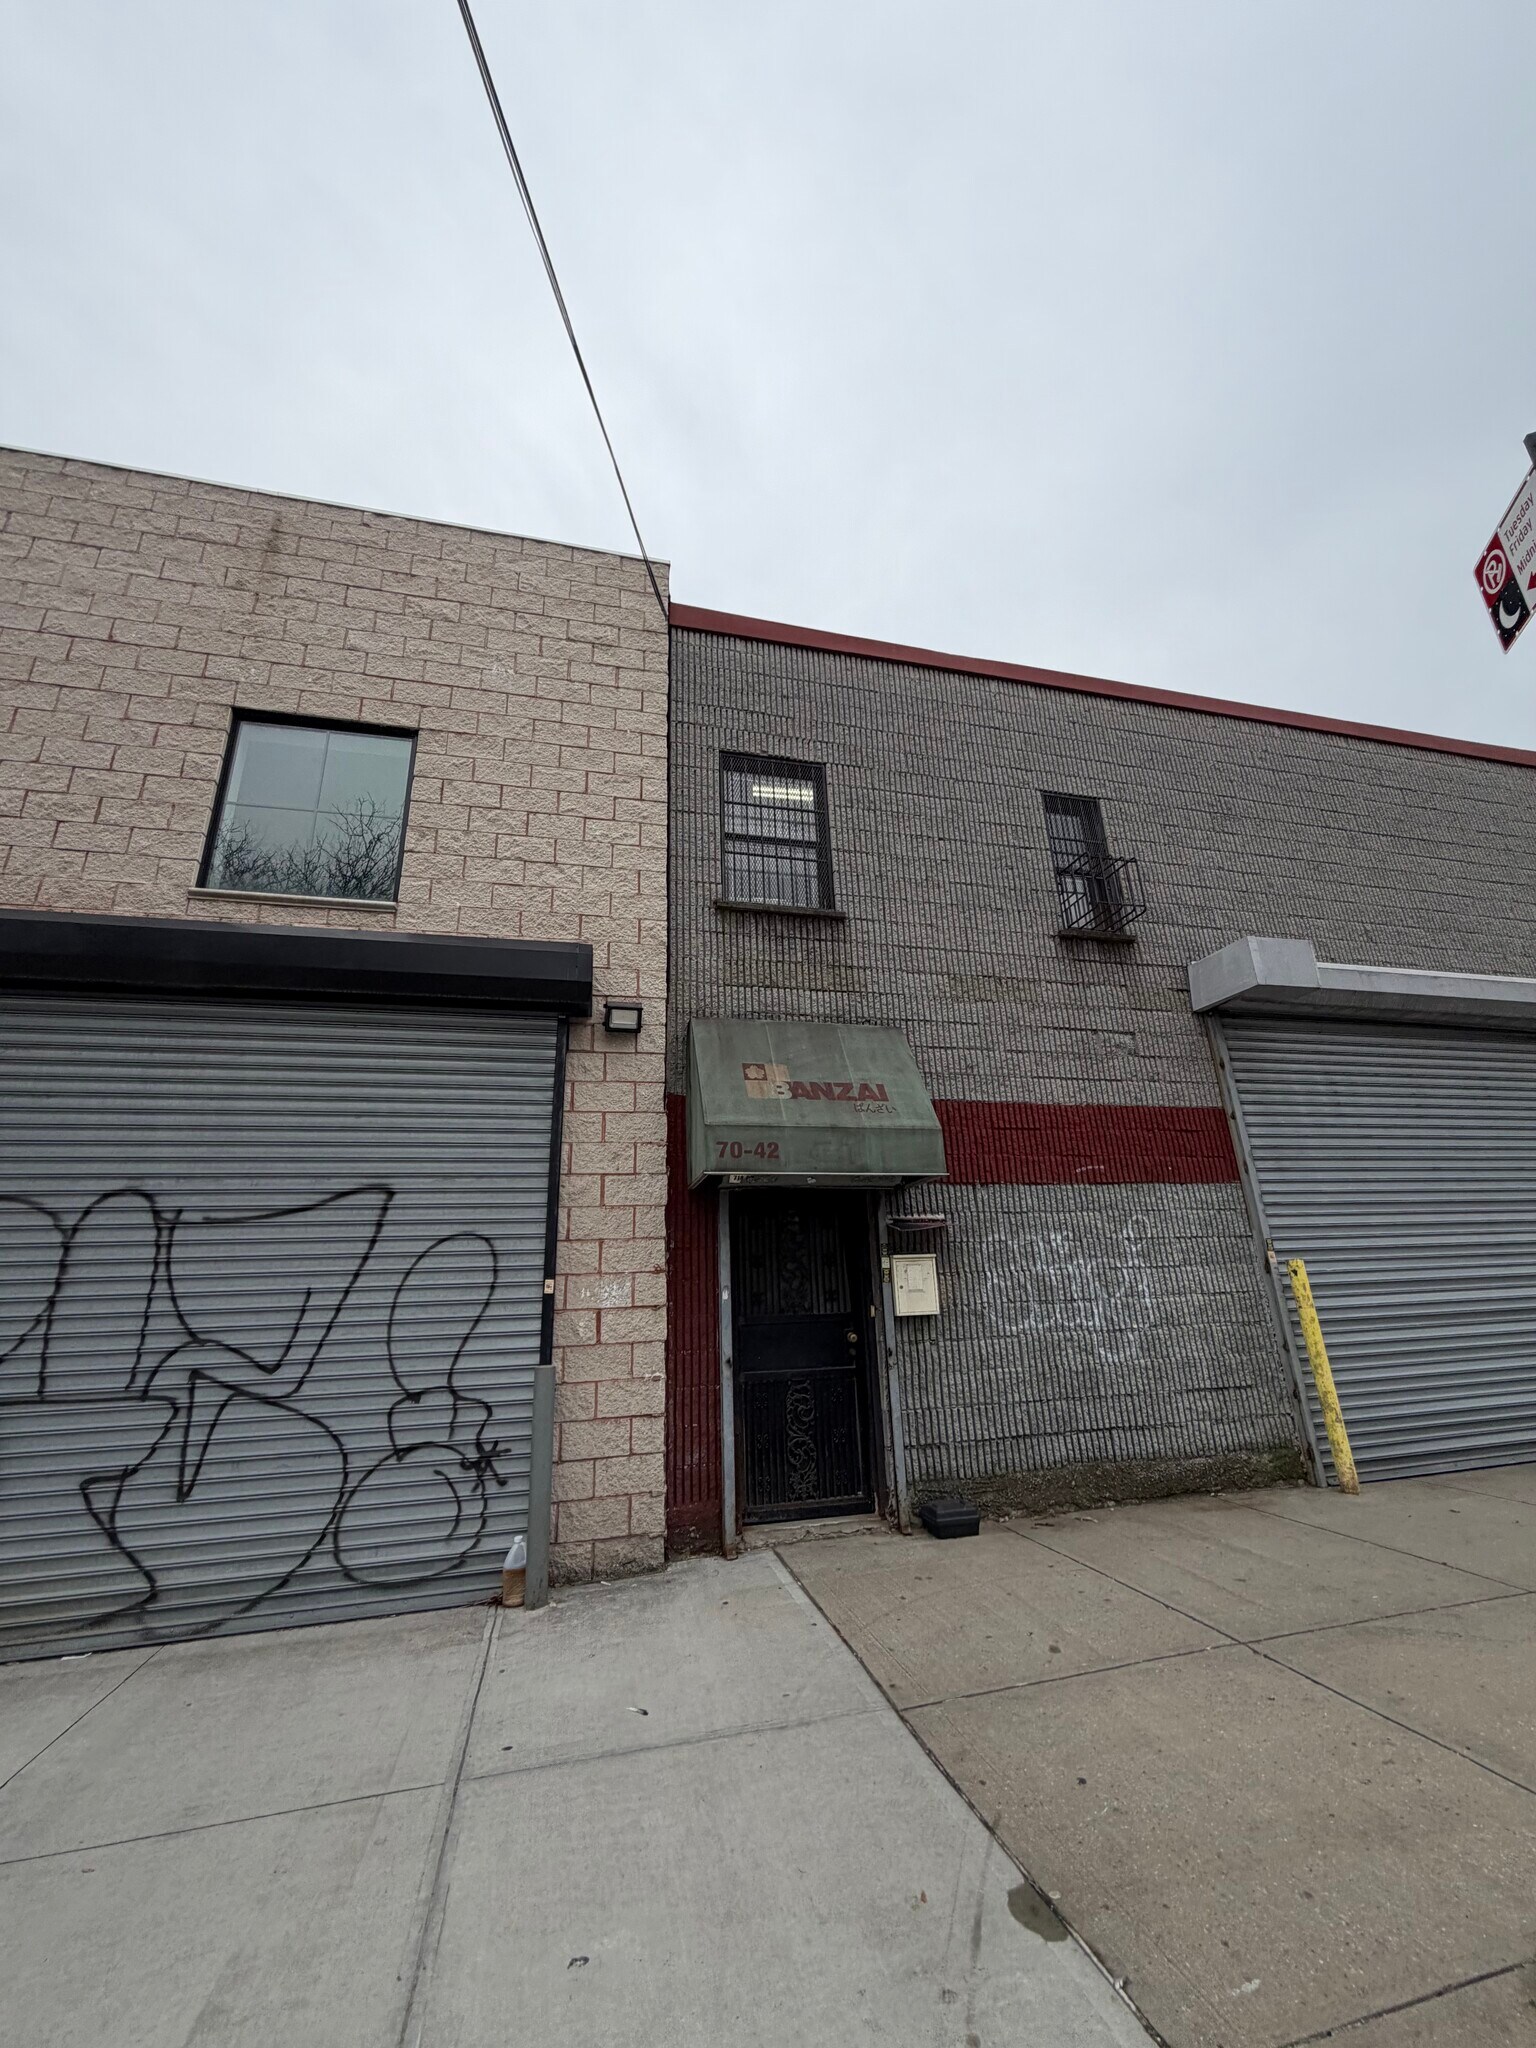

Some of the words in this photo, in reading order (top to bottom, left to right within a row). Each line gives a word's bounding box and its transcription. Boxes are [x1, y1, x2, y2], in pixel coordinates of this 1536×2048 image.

[1504, 492, 1534, 542] Tuesday
[1508, 518, 1533, 557] Friday
[772, 1080, 890, 1102] BANZAI
[716, 1141, 780, 1159] 70-42
